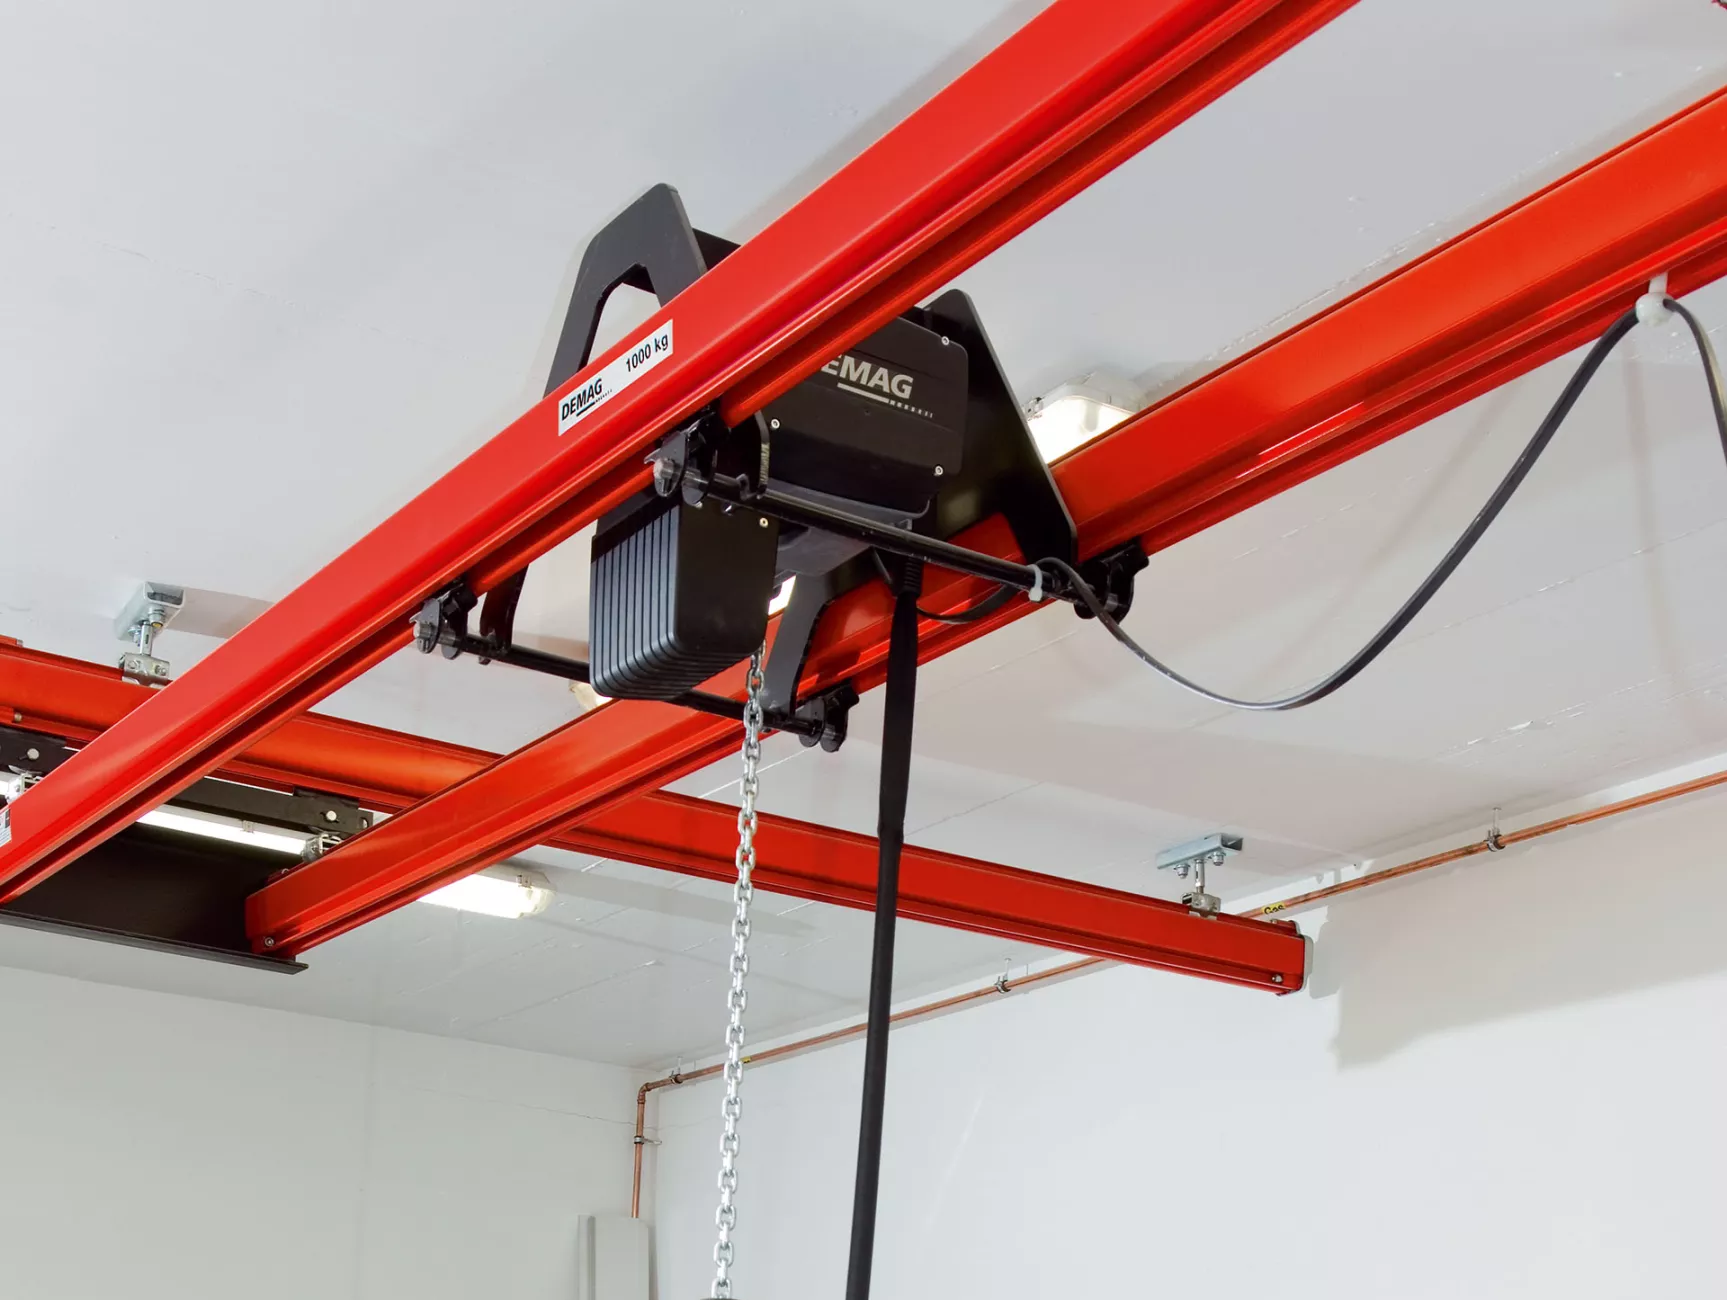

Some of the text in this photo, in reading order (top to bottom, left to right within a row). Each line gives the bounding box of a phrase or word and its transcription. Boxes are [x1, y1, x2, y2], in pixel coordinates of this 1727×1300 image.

[561, 334, 669, 421] DEMAG 1000 kg
[820, 354, 914, 399] EMAG
